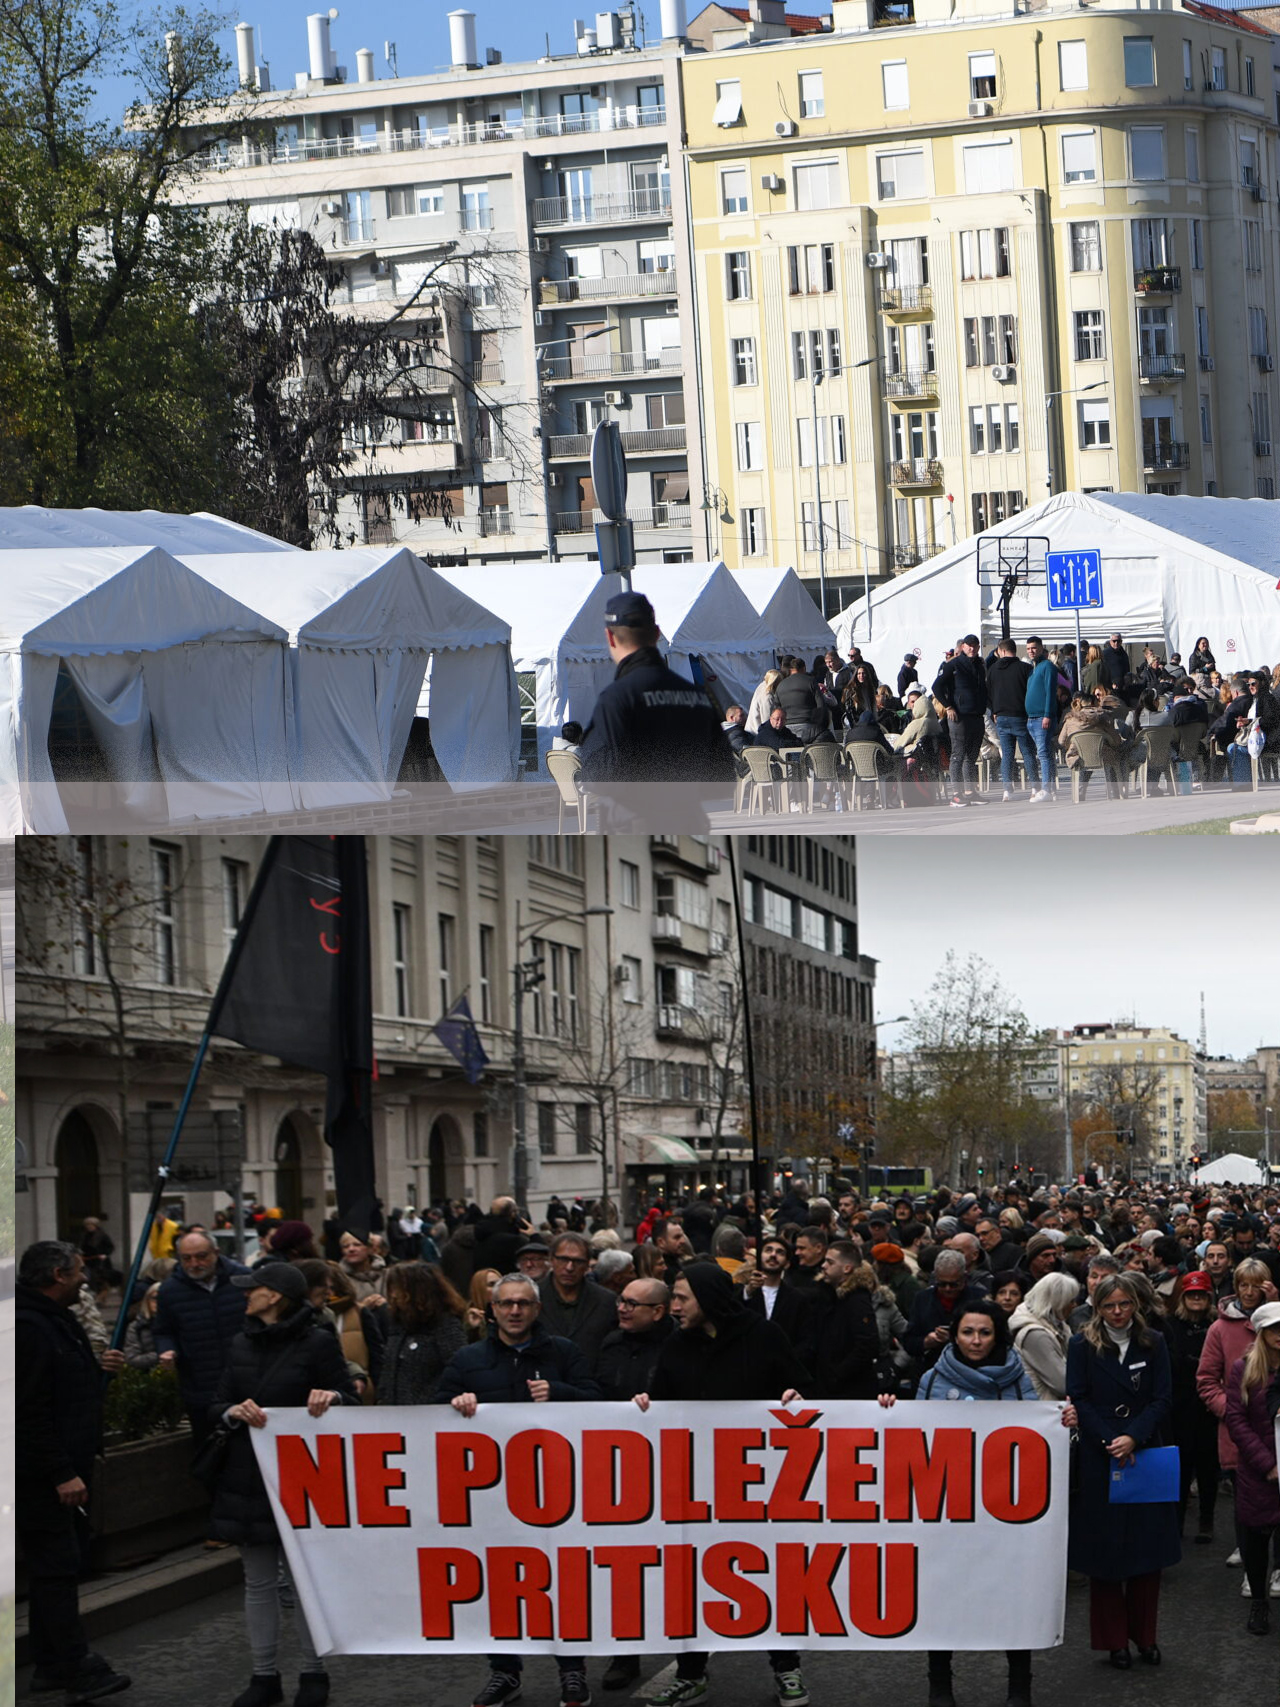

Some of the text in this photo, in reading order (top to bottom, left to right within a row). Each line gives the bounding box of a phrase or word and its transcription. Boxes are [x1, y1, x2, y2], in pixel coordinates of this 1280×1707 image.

[276, 1409, 1051, 1528] NE PODLEŽEMO
[417, 1541, 918, 1642] PRITISKU
